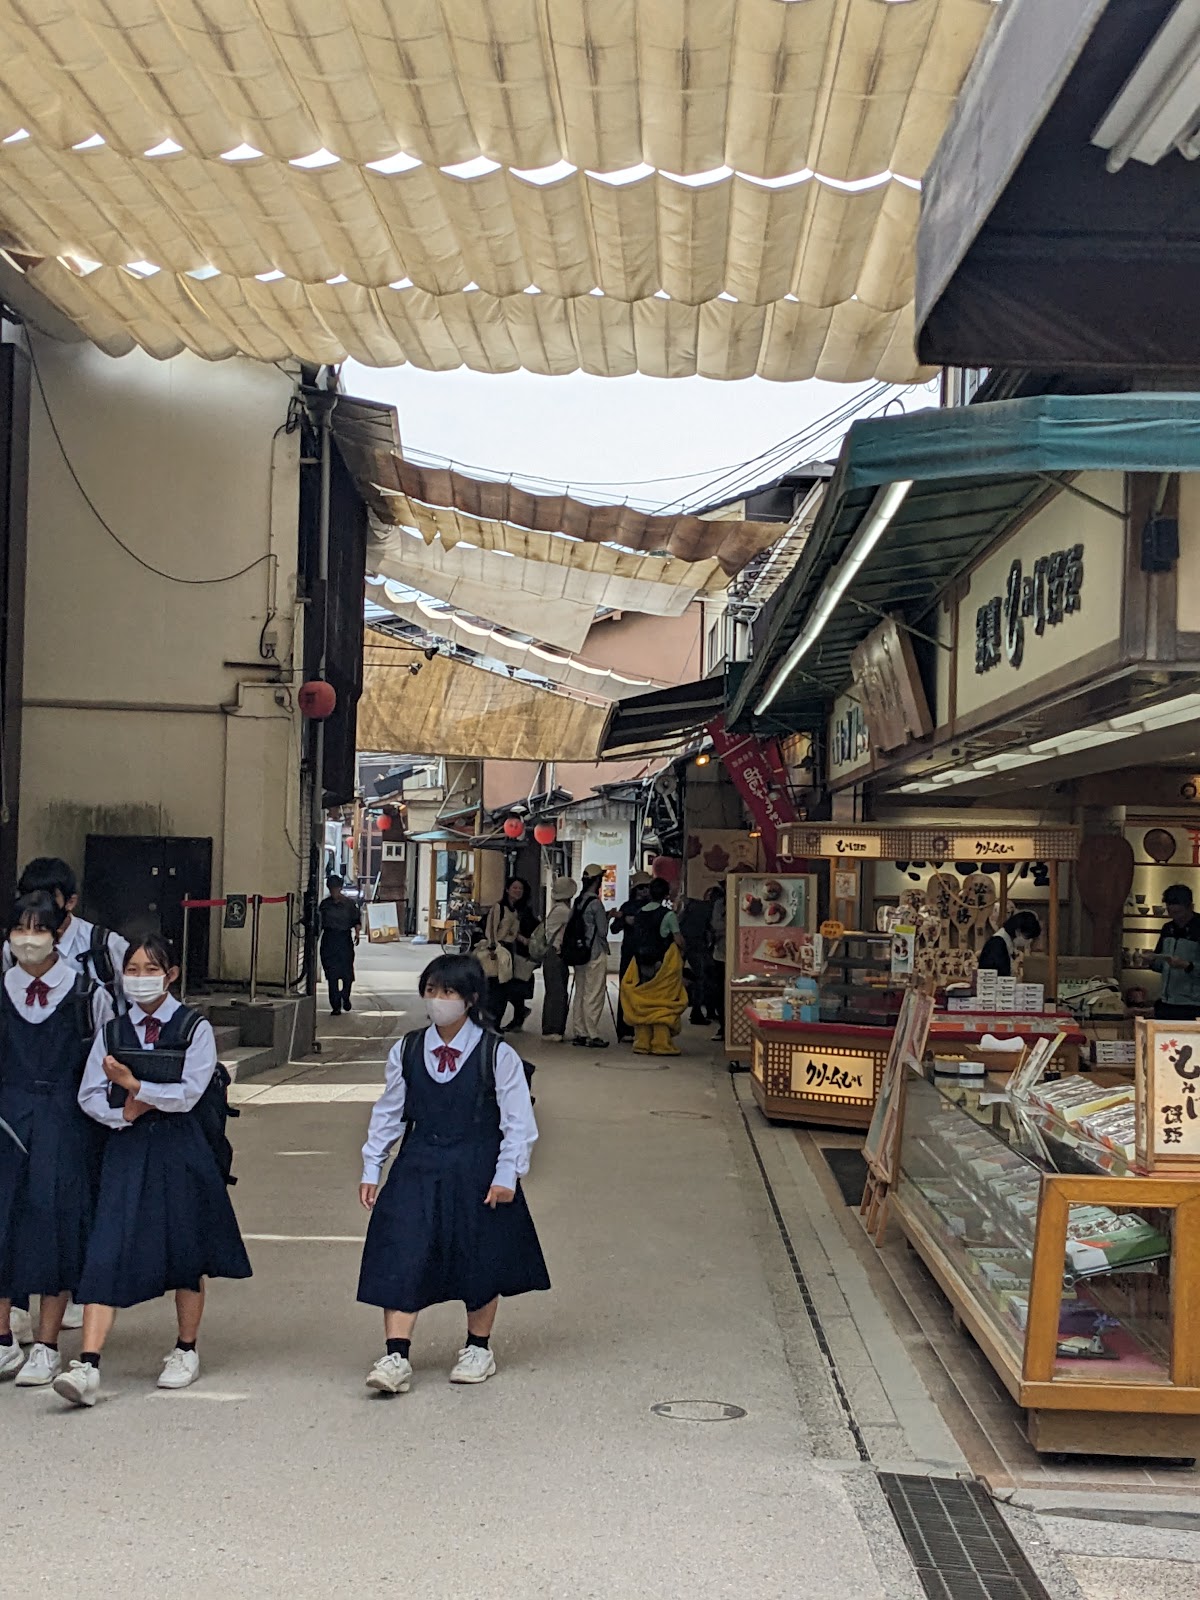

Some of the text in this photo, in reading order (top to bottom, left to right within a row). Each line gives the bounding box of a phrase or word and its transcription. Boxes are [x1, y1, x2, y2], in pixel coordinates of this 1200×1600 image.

[806, 1059, 863, 1089] クリームもみじ
